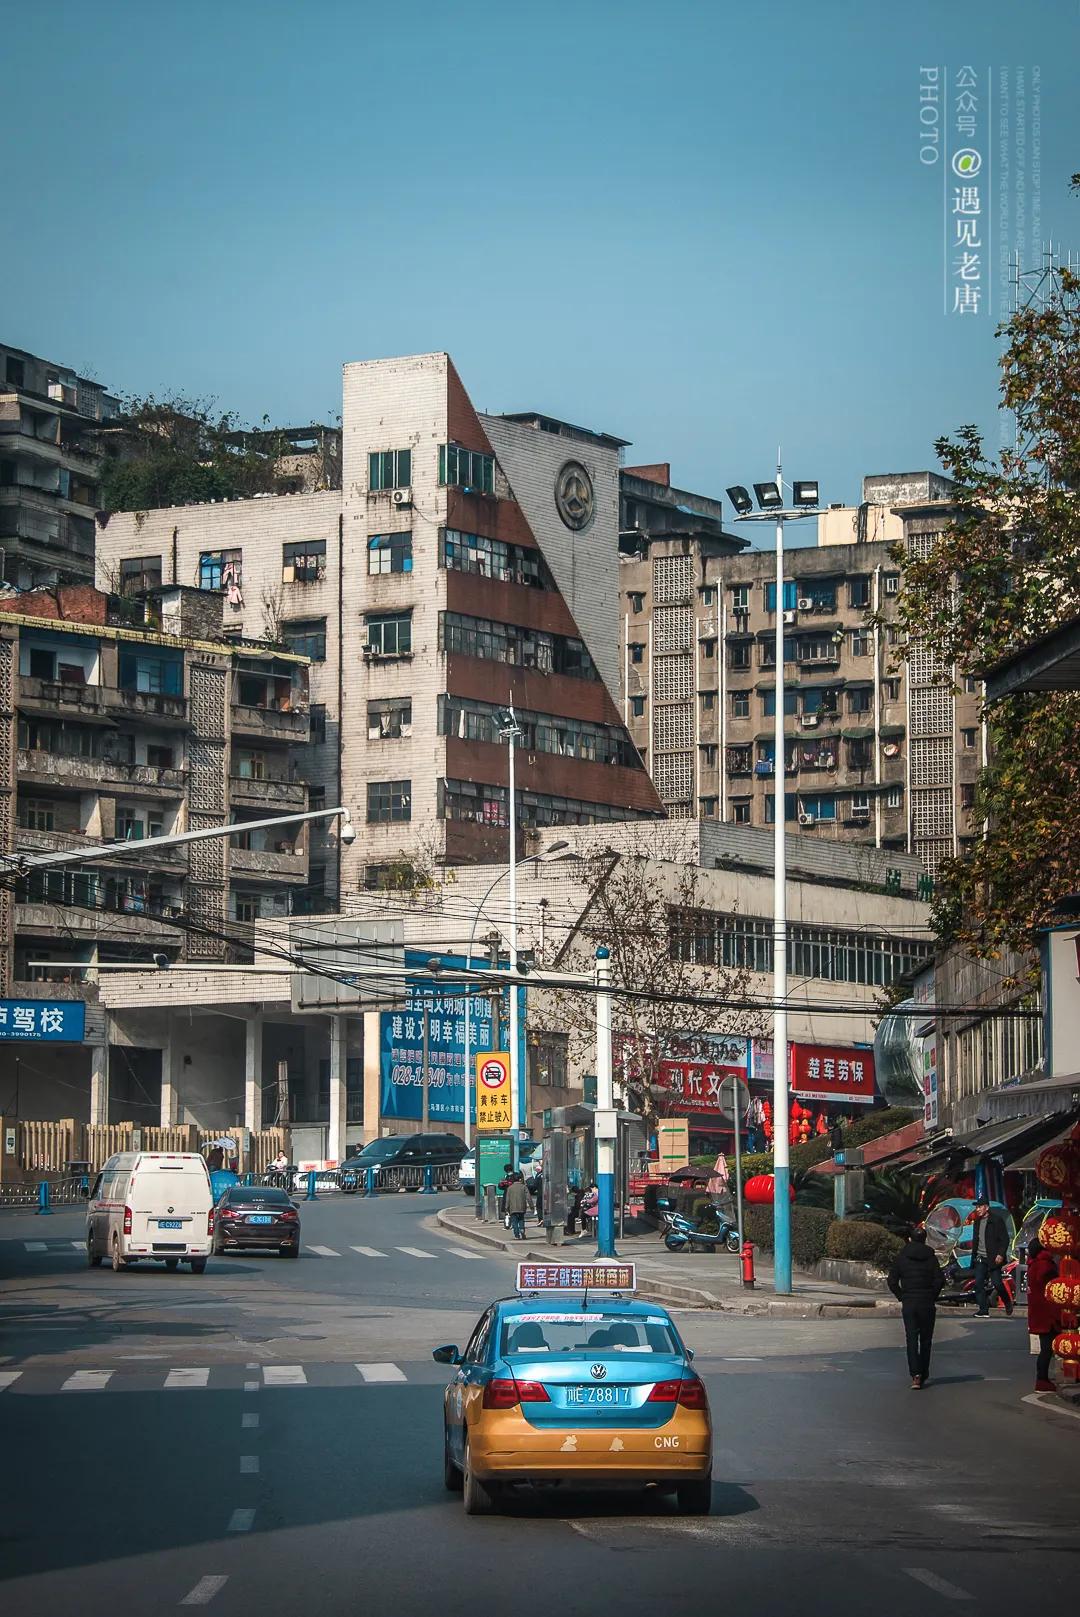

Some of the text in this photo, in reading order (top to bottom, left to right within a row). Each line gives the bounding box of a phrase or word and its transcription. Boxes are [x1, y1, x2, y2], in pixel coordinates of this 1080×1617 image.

[392, 1015, 510, 1047] 建设文明幸福美丽州
[808, 1057, 864, 1082] 楚军劳保
[480, 1094, 508, 1106] 黄标车
[480, 1110, 510, 1122] 禁止驶入
[567, 1387, 629, 1402] 川E·Z8817
[654, 1436, 680, 1448] CNG
